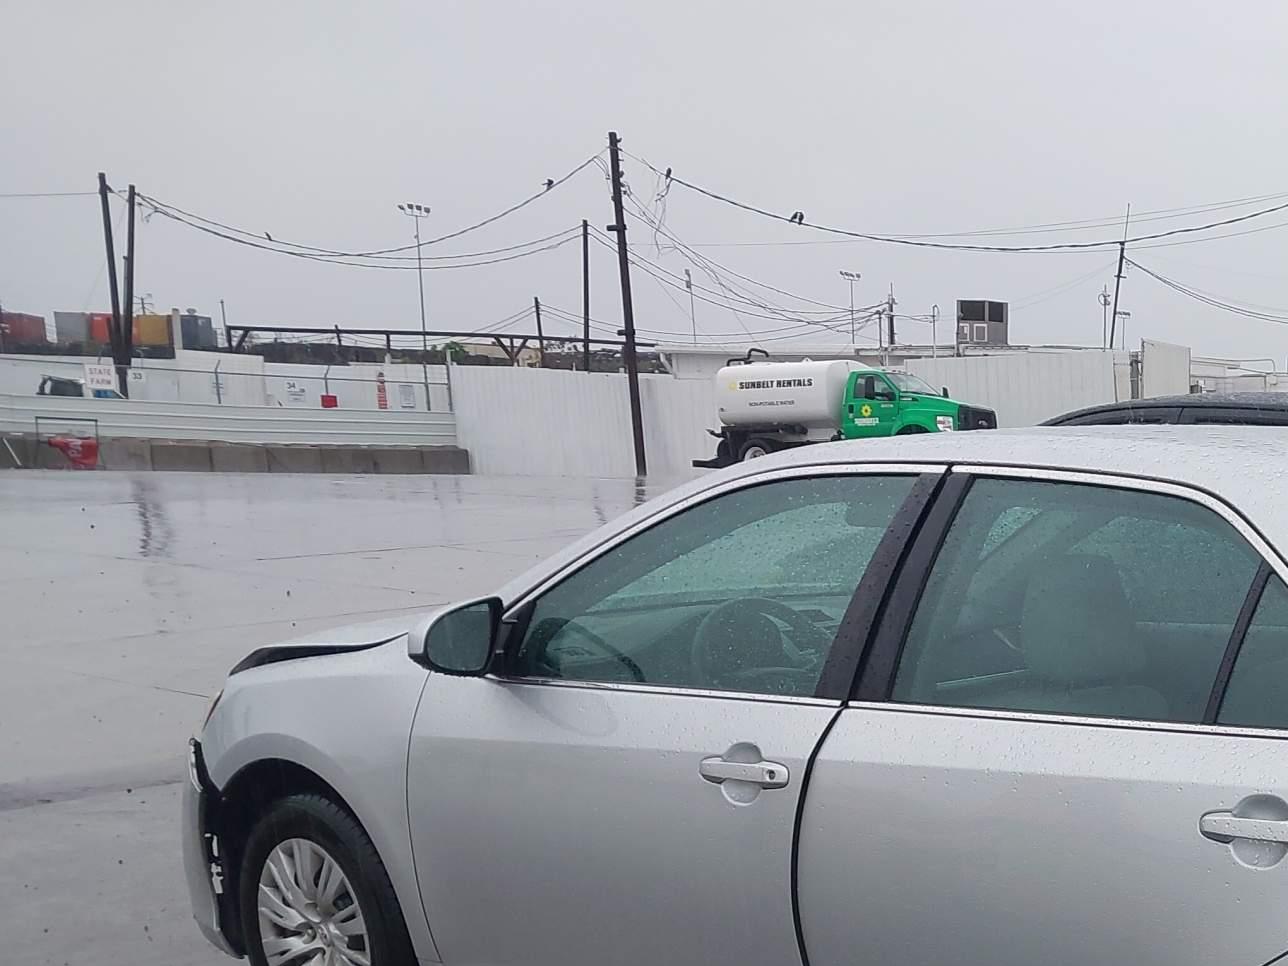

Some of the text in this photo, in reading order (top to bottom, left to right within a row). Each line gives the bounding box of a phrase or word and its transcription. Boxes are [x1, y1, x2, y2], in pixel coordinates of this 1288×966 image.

[88, 367, 111, 376] STATE
[90, 377, 111, 385] FARM
[286, 381, 296, 390] 34
[738, 378, 813, 390] SUNBELT RENTALS
